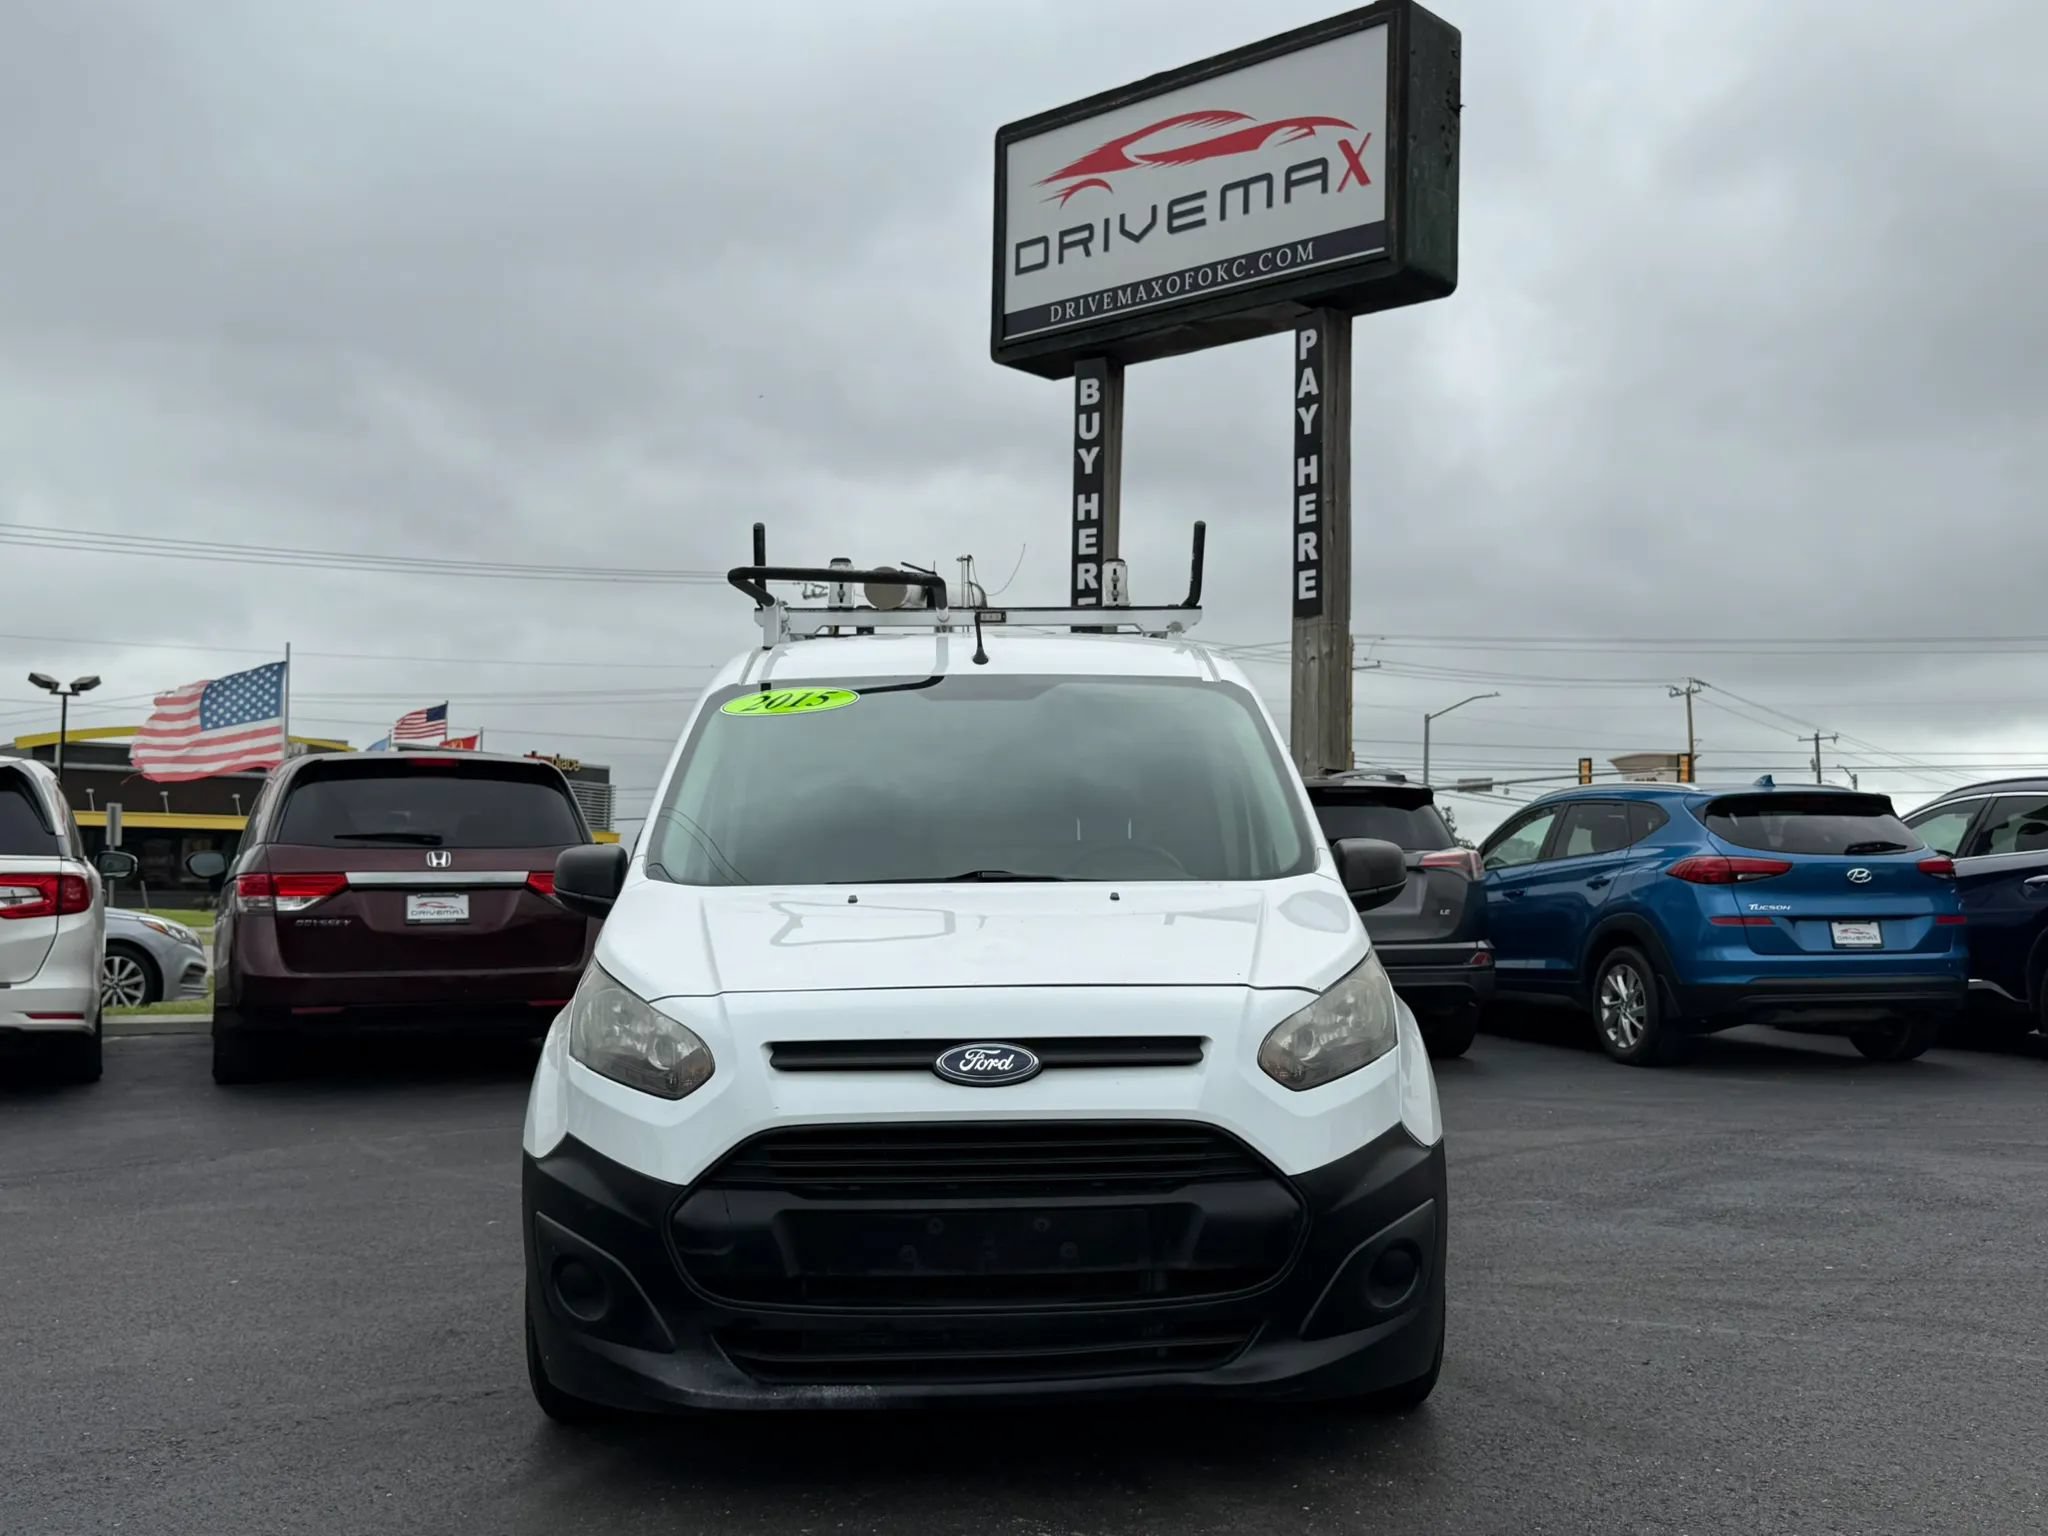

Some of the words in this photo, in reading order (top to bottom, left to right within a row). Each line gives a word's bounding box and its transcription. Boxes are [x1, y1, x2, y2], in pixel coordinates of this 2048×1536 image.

[1015, 132, 1372, 277] DRIVEMAX
[1049, 240, 1315, 323] DRIVEMAXOFOKC.COM
[1077, 378, 1101, 474] BUY
[1296, 328, 1319, 435] PAY
[1296, 455, 1319, 600] HERE
[739, 691, 840, 713] 2015
[959, 1049, 1015, 1071] Ford
